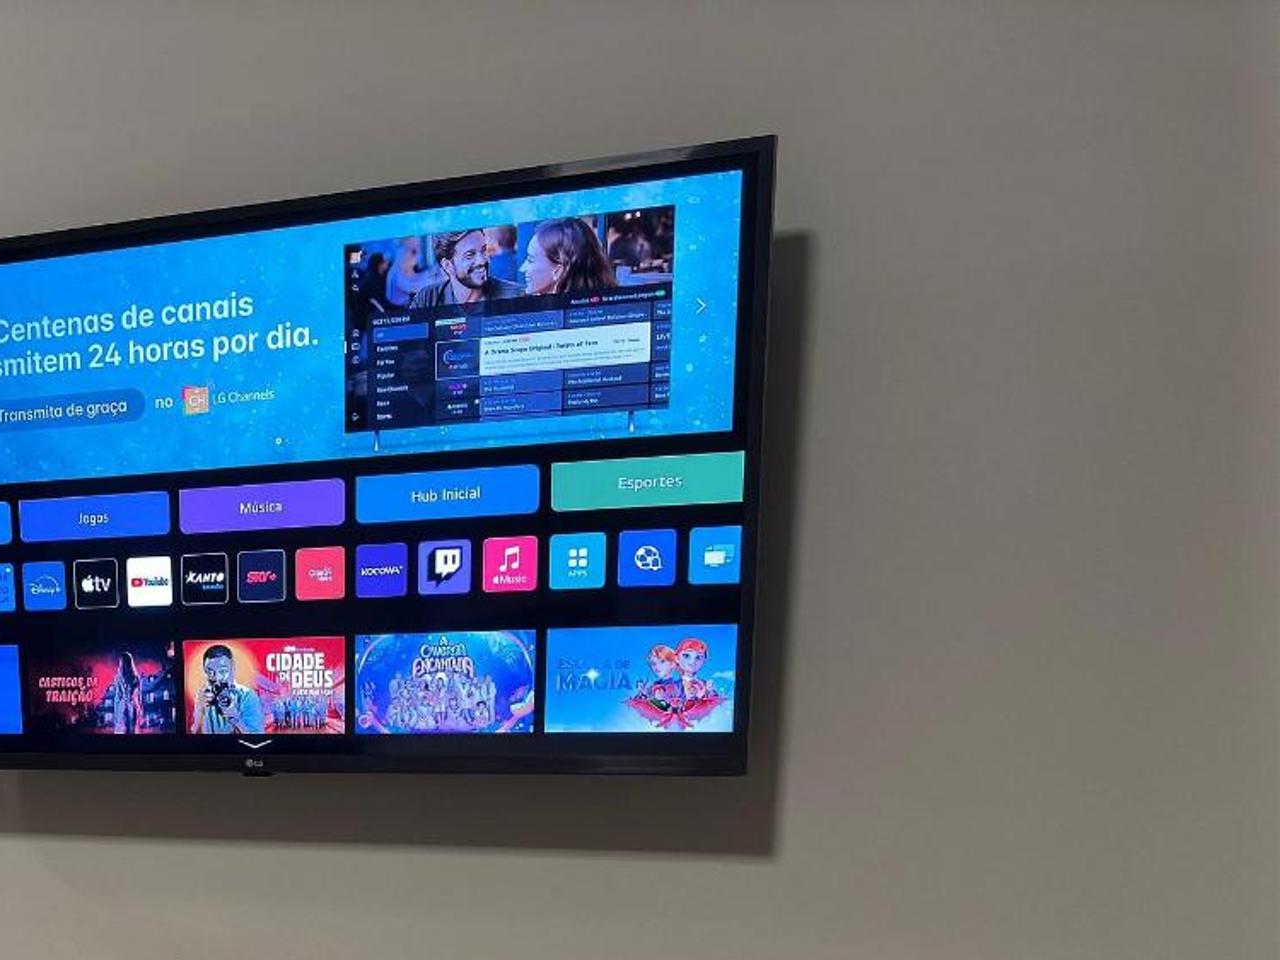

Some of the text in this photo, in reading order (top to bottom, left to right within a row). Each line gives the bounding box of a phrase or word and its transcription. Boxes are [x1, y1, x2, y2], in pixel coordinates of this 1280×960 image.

[122, 304, 154, 329] de
[161, 291, 254, 325] canais
[88, 342, 121, 368] 24
[128, 337, 205, 364] horas
[213, 330, 259, 363] por
[266, 321, 319, 350] dia.
[155, 396, 174, 409] no
[229, 389, 275, 403] Channels
[66, 402, 83, 417] de
[86, 401, 128, 419] graça
[618, 475, 683, 492] Esportes
[411, 486, 481, 503] Hub Inicial
[239, 501, 282, 515] Música
[79, 512, 109, 526] Jogos
[93, 575, 111, 592] tv
[143, 577, 169, 587] YouTube
[499, 573, 527, 583] Music
[265, 652, 325, 672] CIDADE
[291, 669, 333, 689] DEUS
